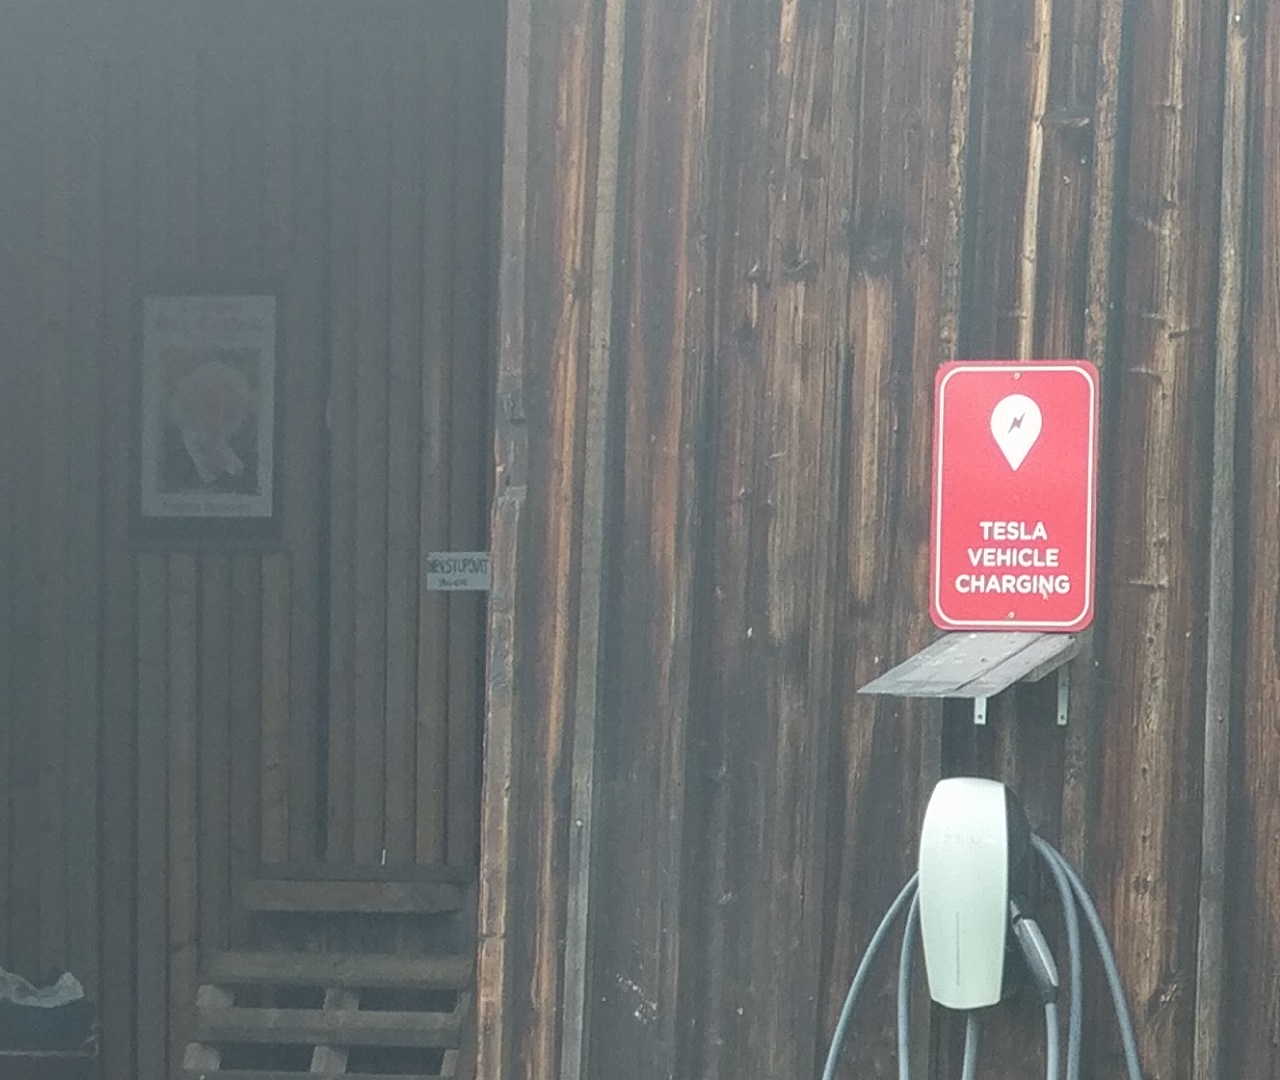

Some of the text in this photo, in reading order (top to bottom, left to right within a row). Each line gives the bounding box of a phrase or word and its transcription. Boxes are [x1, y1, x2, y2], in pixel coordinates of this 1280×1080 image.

[980, 522, 1047, 540] TESLA
[968, 549, 1058, 566] VEHICLE
[955, 575, 1070, 594] CHARGING
